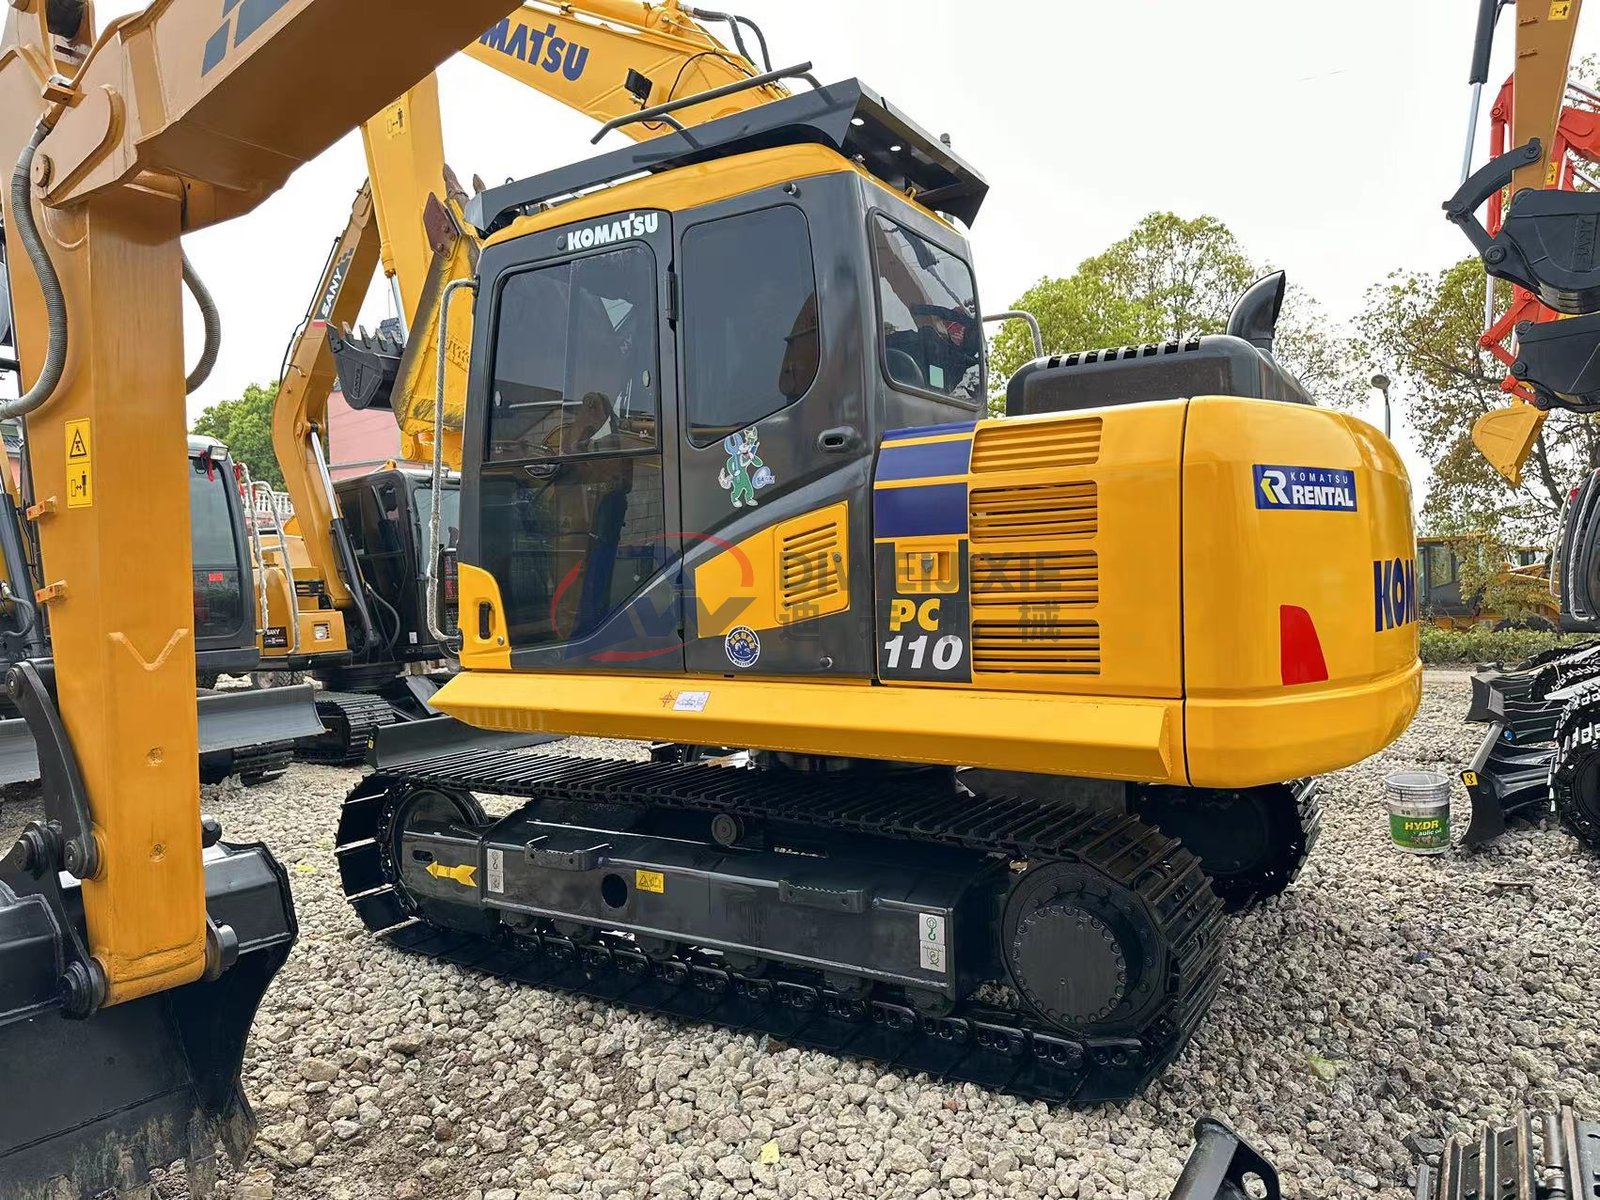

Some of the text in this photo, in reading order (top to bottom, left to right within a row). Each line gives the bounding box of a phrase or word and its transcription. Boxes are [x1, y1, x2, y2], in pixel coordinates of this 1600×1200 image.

[567, 212, 658, 251] KOMATSU
[321, 267, 342, 317] SANY
[1290, 472, 1348, 484] KOMATSU
[1291, 485, 1354, 507] RENTAL
[889, 598, 941, 632] PC
[884, 635, 963, 671] 110
[1405, 820, 1439, 830] HYDR
